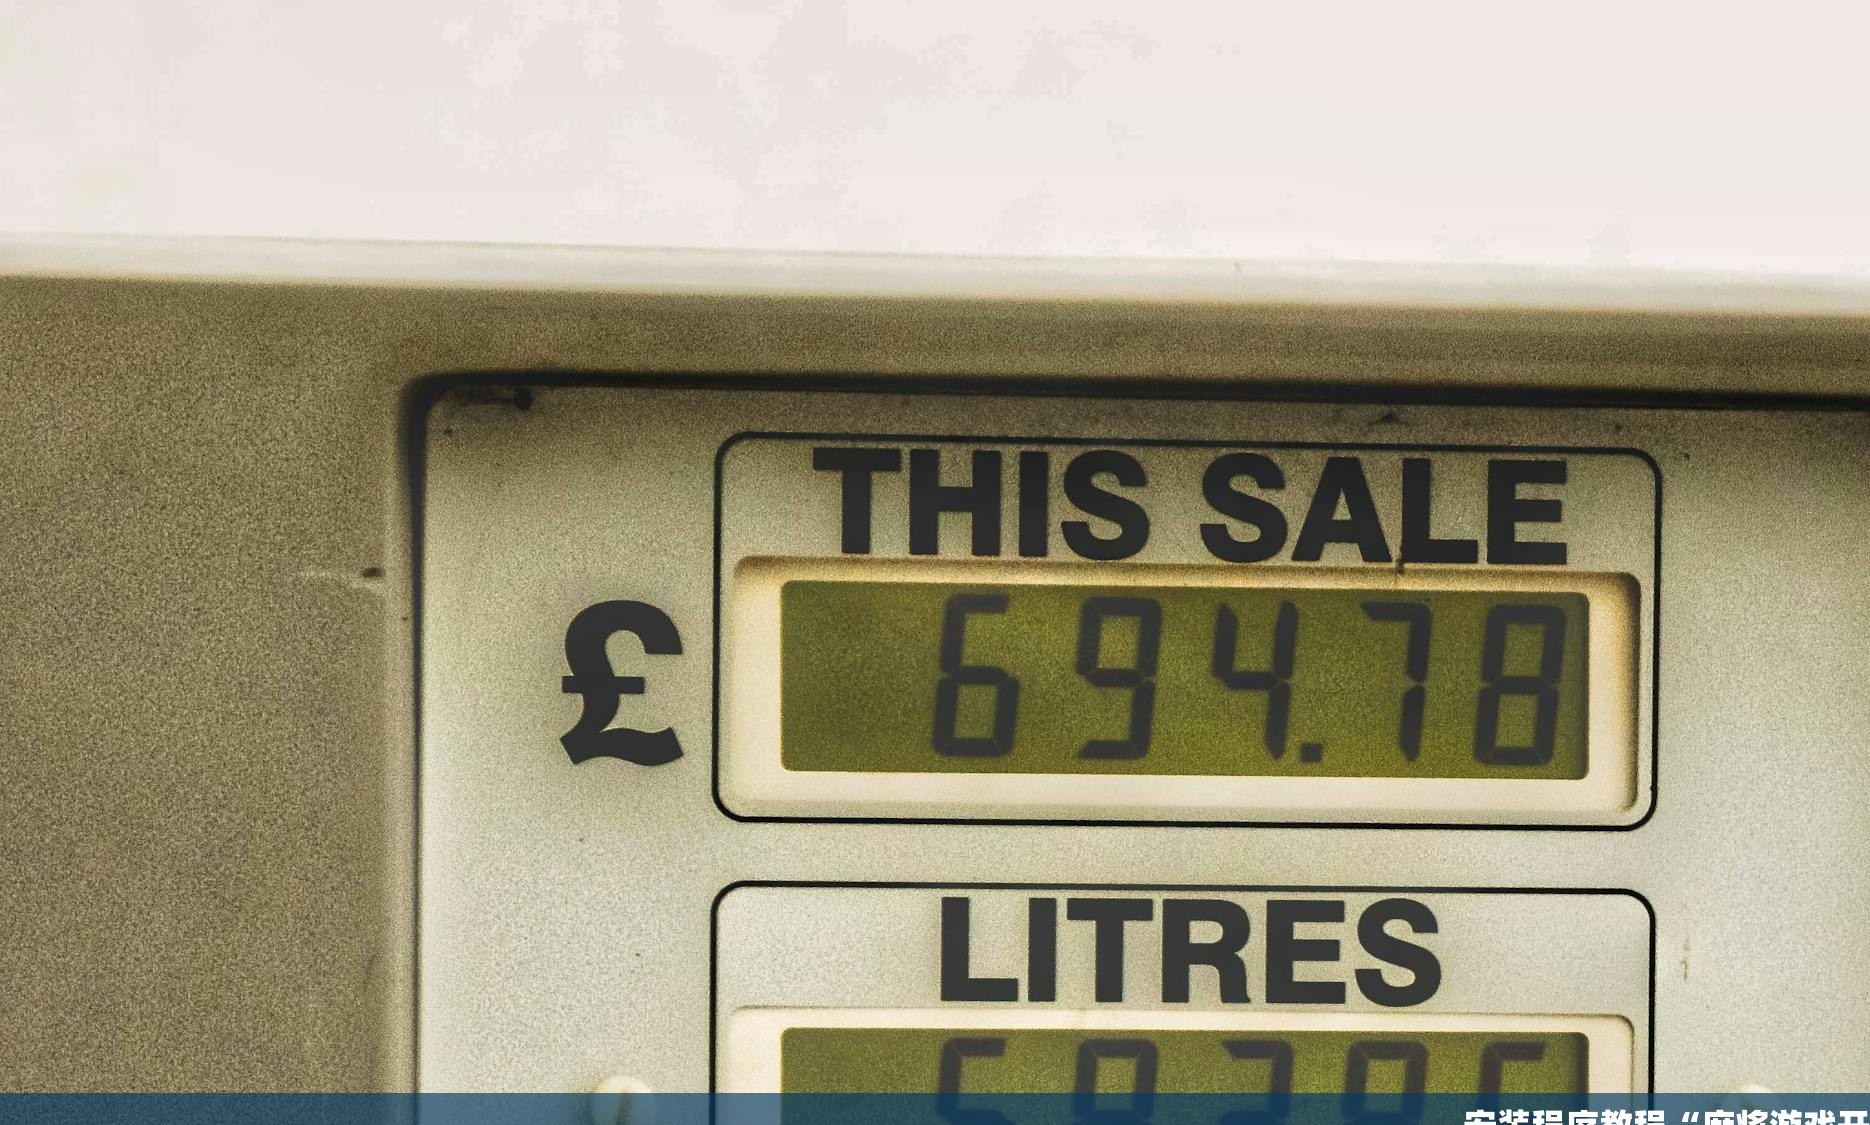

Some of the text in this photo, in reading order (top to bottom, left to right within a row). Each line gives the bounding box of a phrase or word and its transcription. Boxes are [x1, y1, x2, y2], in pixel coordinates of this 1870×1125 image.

[811, 447, 1569, 565] THIS SALE
[559, 599, 684, 767] £
[930, 593, 1569, 767] 694.78
[940, 896, 1442, 1008] LITRES
